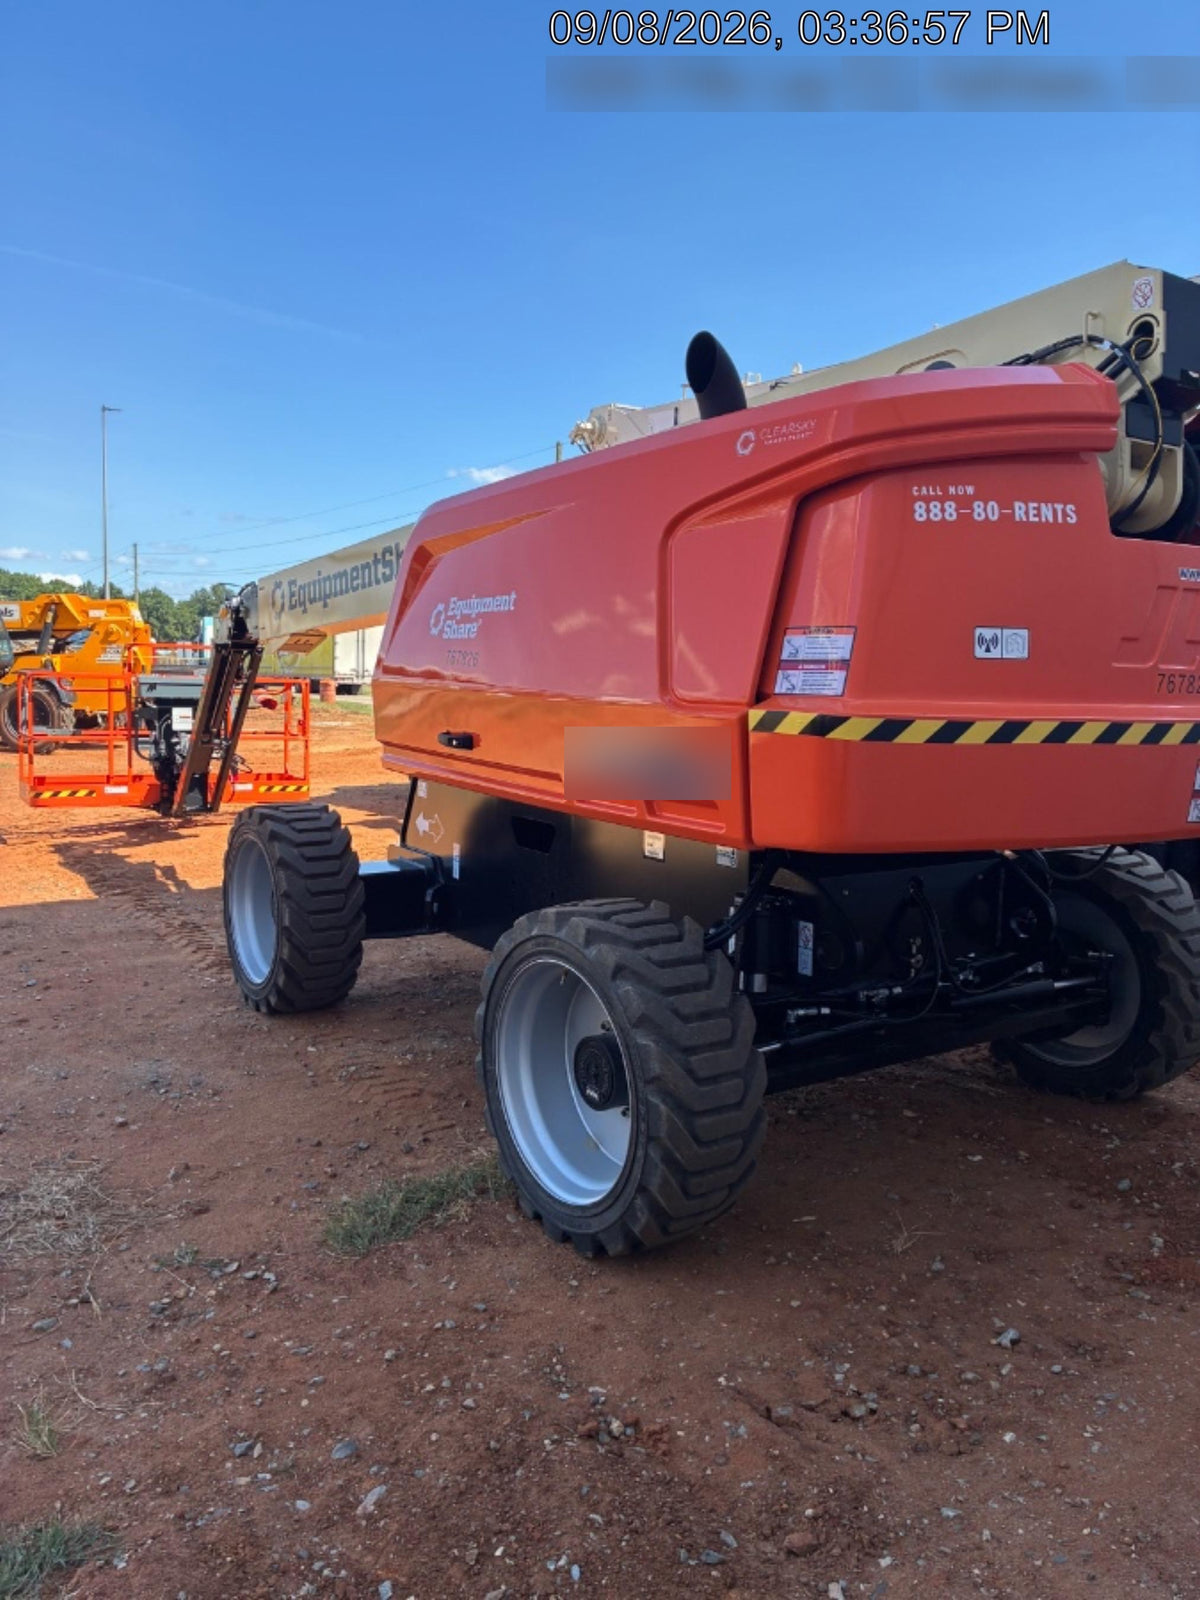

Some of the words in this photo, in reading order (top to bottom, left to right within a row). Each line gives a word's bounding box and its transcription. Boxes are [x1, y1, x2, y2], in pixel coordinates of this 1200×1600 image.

[912, 486, 943, 496] CALL
[949, 485, 975, 495] NOW
[913, 500, 1078, 524] 888-80-RENTS
[447, 590, 517, 619] Equipment
[442, 618, 478, 639] Share
